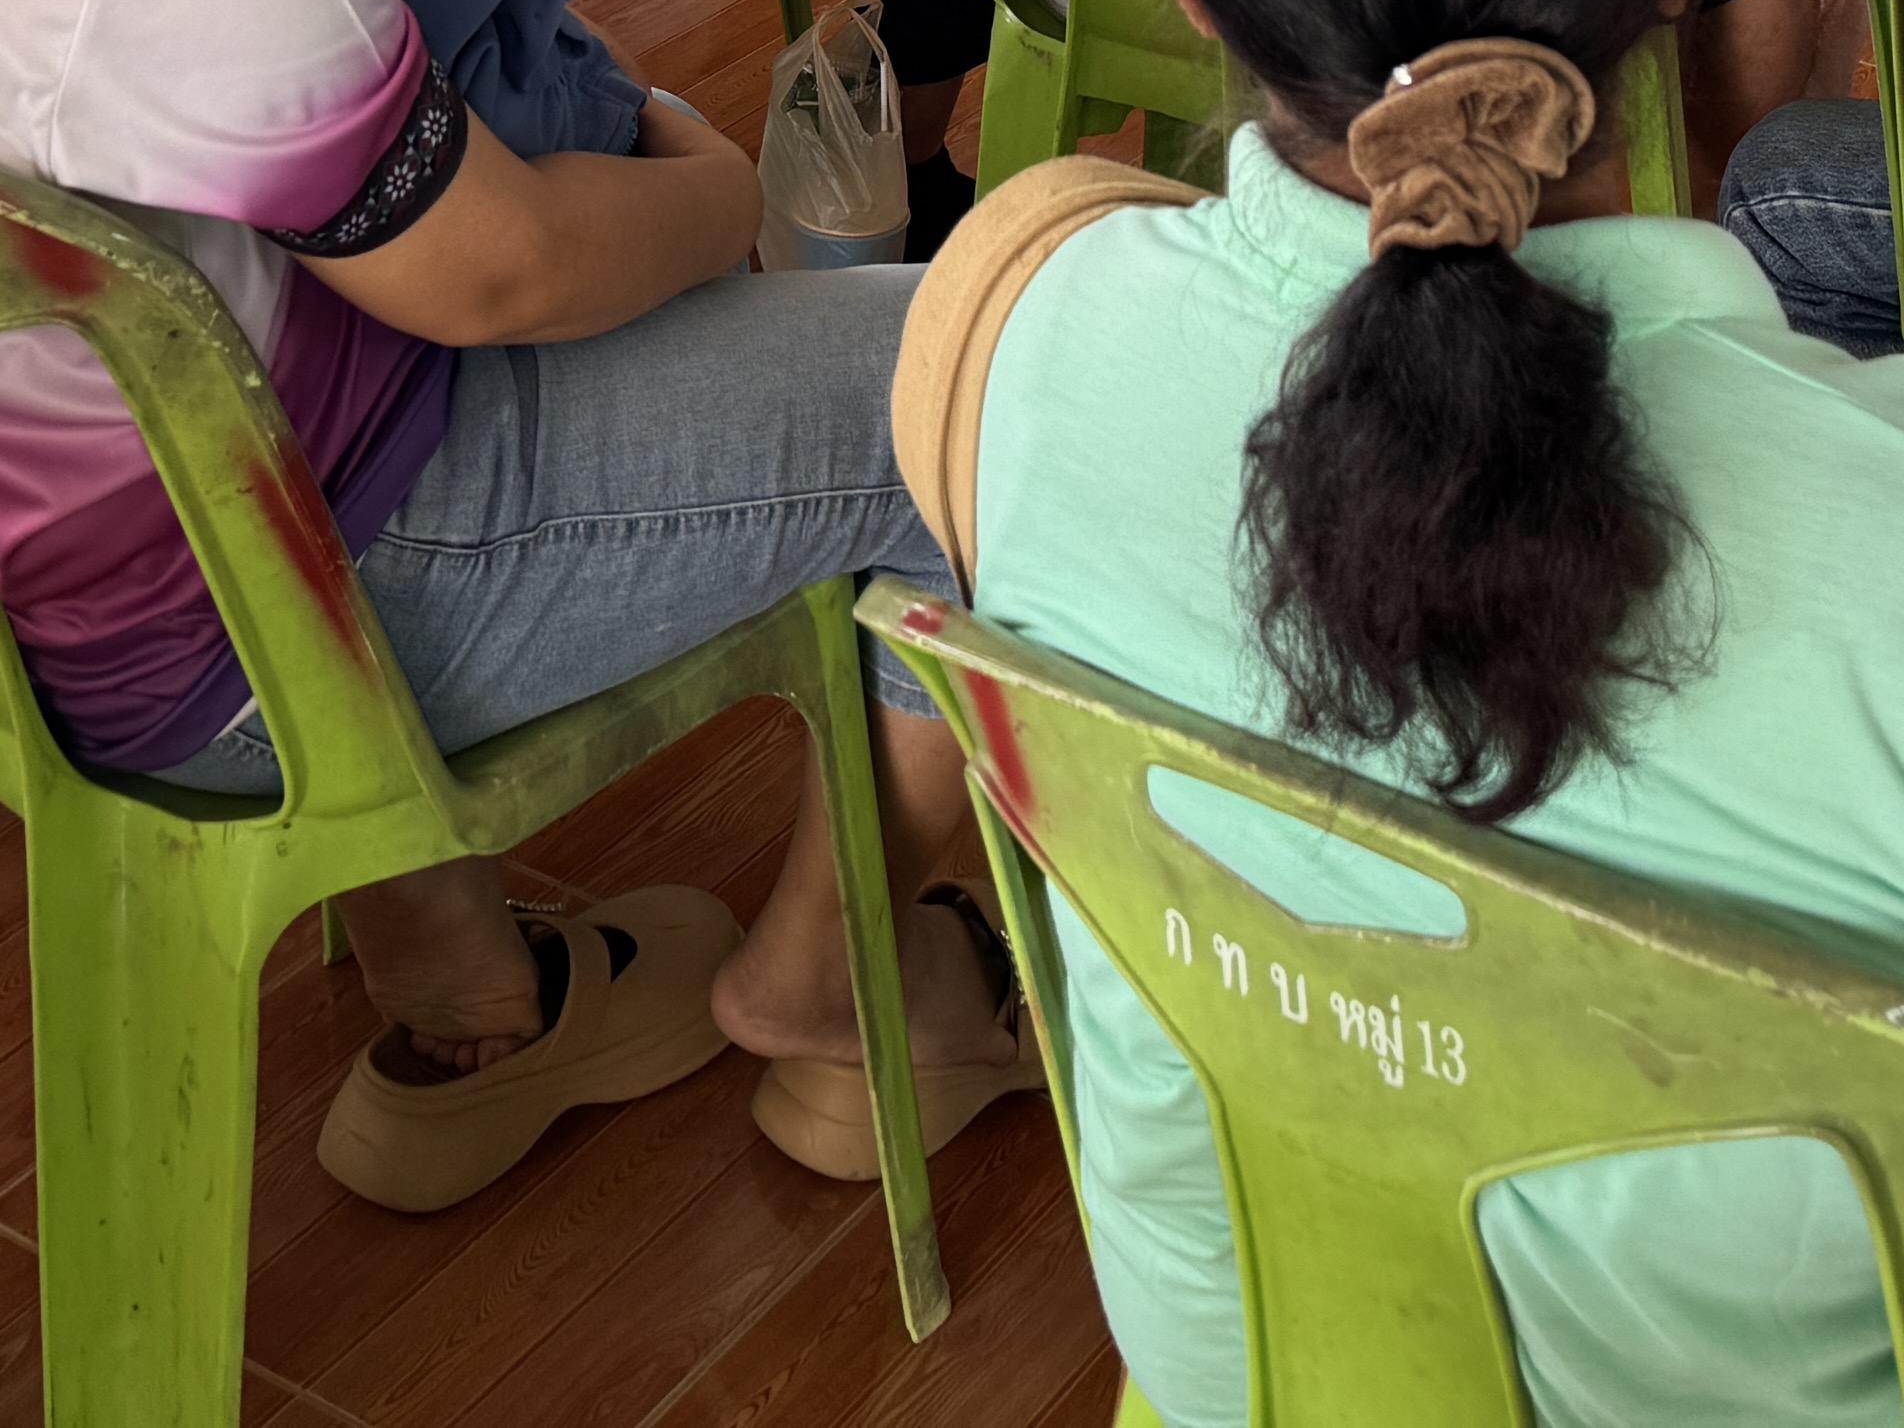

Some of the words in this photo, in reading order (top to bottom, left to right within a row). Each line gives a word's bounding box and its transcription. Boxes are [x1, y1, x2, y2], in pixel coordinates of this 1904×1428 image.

[1165, 907, 1193, 967] ก
[1212, 932, 1249, 998] ท
[1269, 961, 1309, 1025] บ
[1329, 990, 1405, 1090] หมู่
[1415, 1019, 1467, 1087] 13
